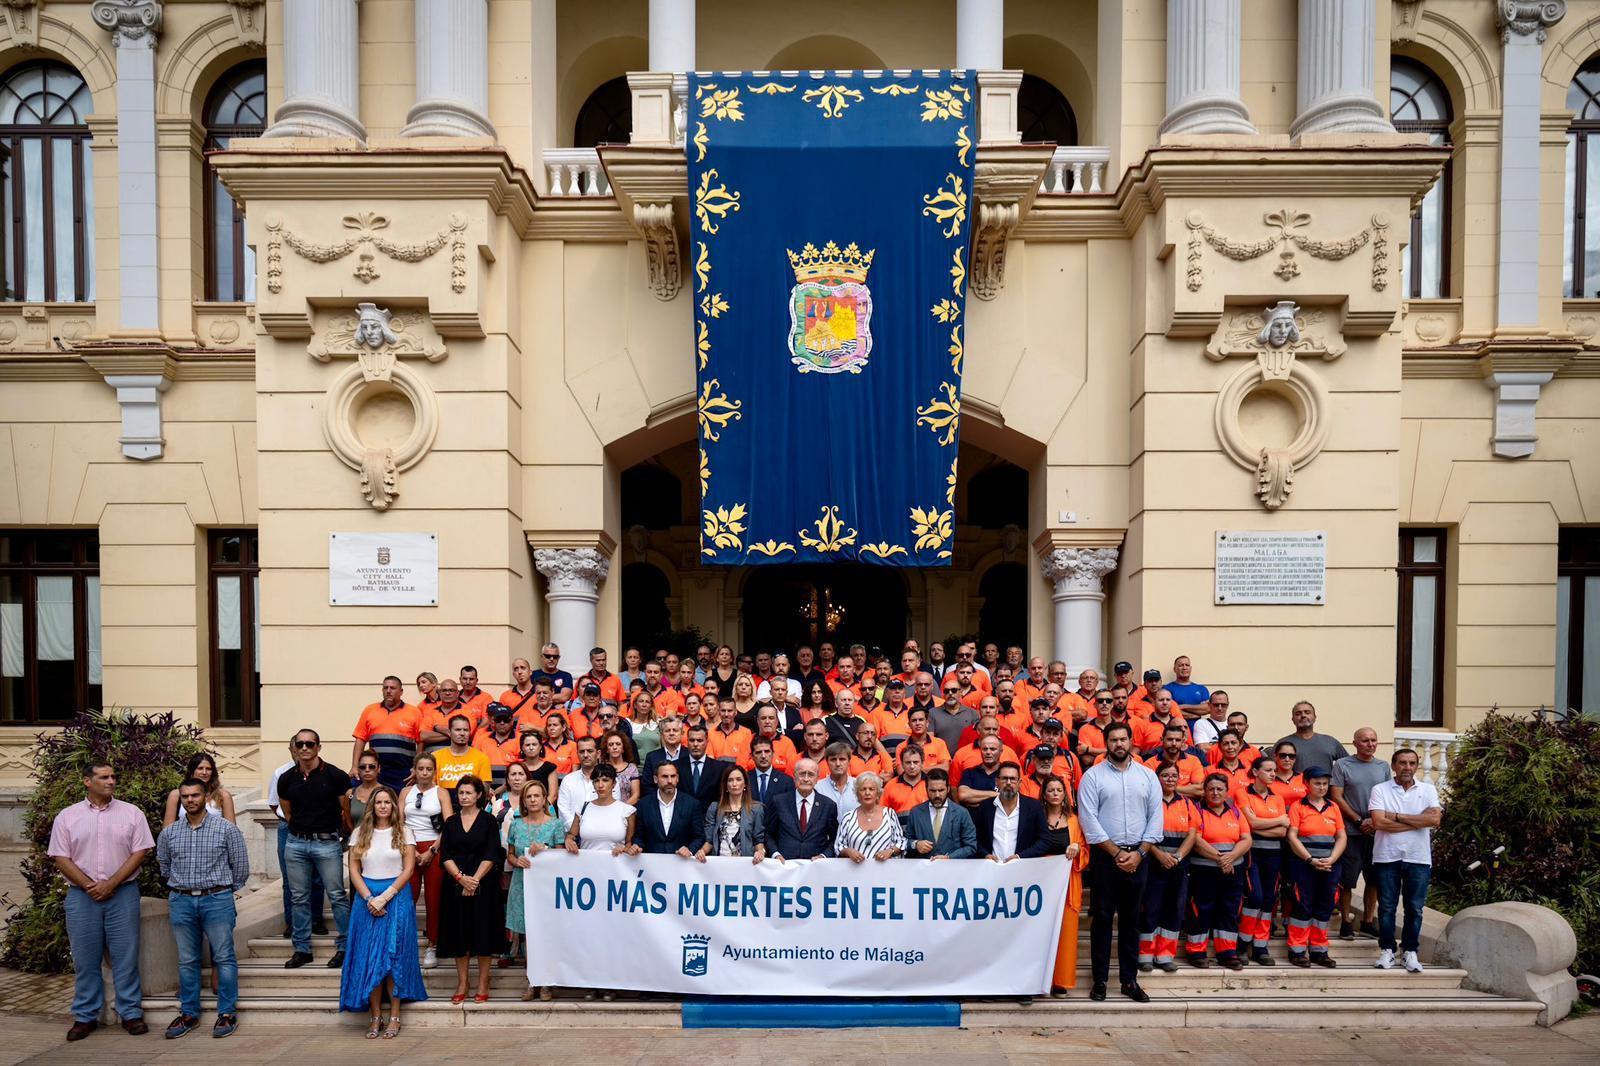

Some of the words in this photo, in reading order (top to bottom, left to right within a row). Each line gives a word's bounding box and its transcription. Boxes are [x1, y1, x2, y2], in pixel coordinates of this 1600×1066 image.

[352, 584, 376, 592] HÔTEL
[555, 876, 597, 911] NO
[608, 870, 668, 915] MÁS
[678, 882, 813, 919] MUERTES
[823, 886, 859, 920] EN
[871, 887, 904, 921] EL
[913, 885, 1043, 921] TRABAJO
[722, 945, 835, 962] Ayuntamiento
[840, 947, 860, 961] de
[864, 947, 924, 965] Málaga
